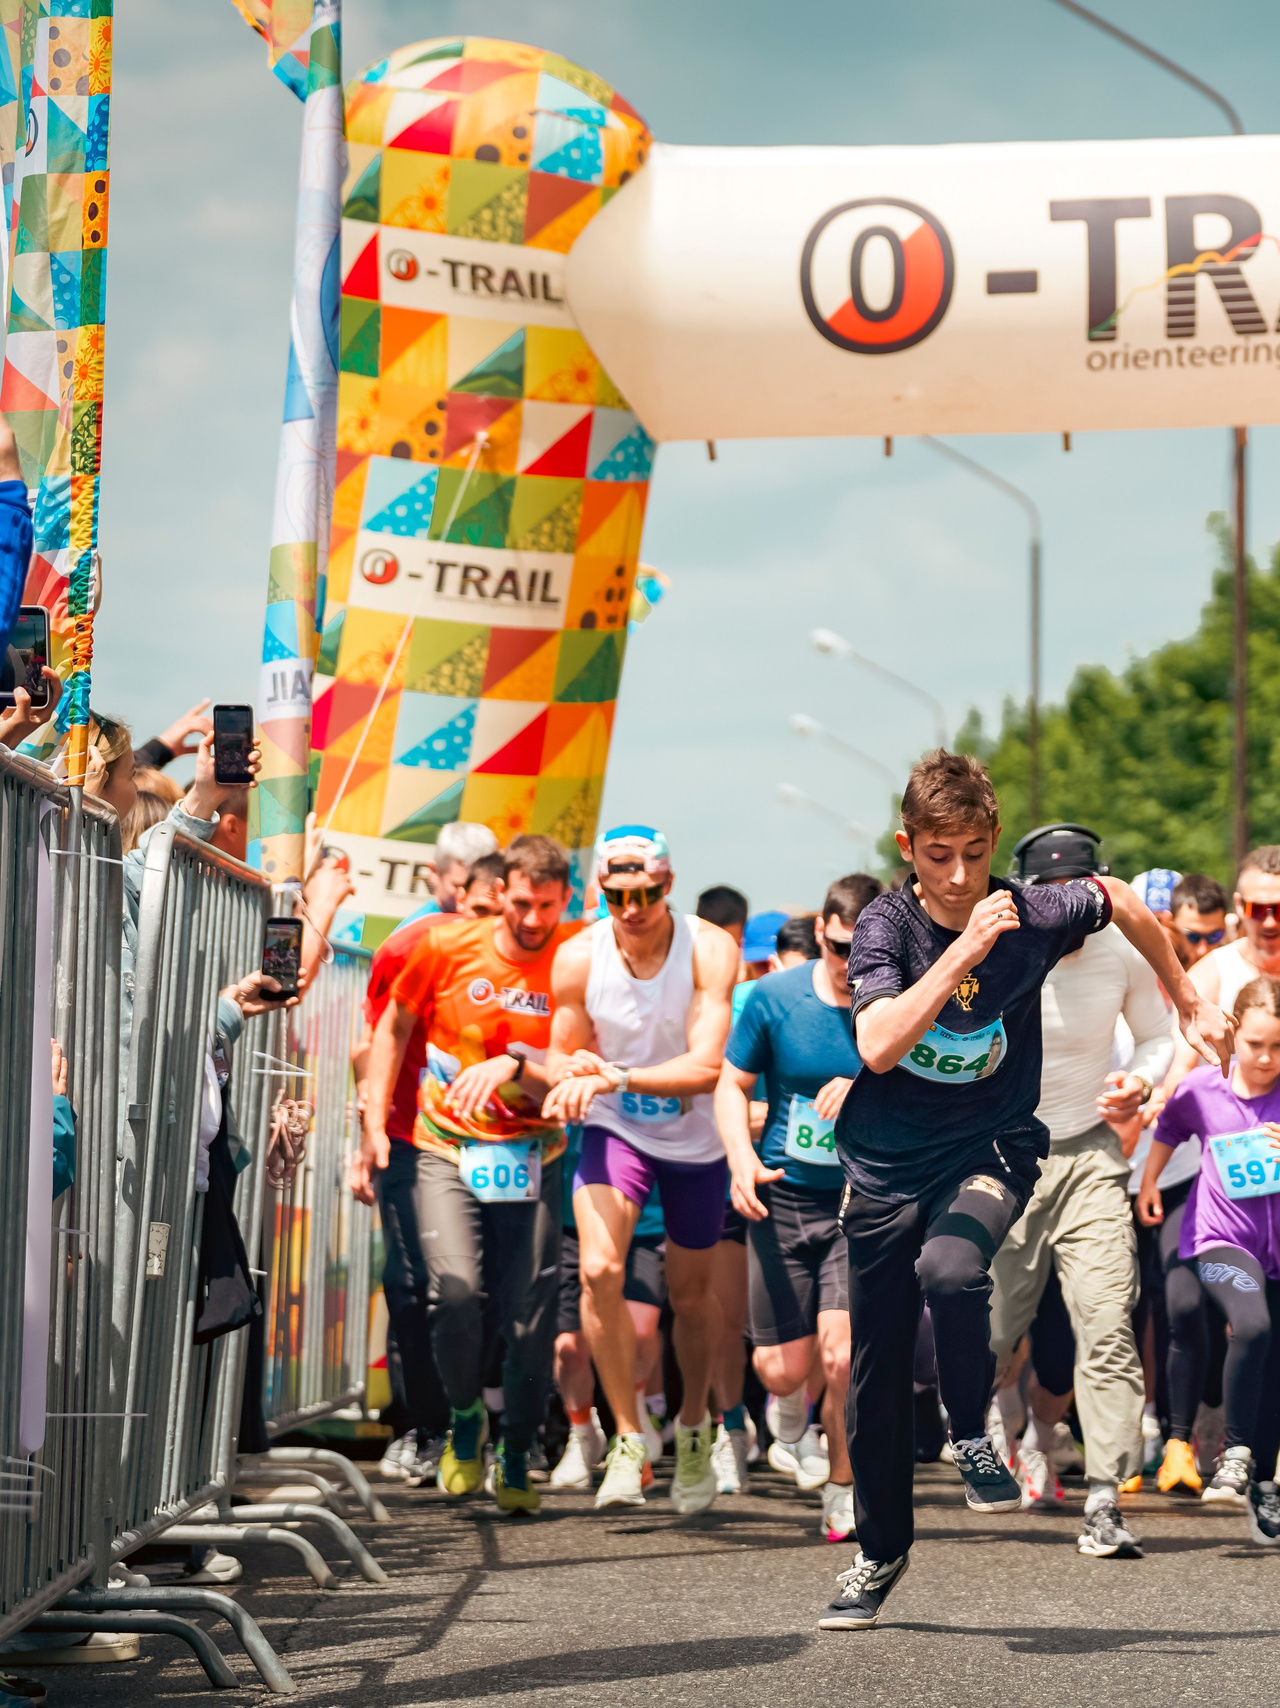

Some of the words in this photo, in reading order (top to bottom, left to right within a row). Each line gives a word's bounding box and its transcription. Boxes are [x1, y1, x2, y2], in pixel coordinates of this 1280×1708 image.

[909, 1043, 991, 1074] 864
[621, 1091, 680, 1116] 553
[471, 1164, 529, 1189] 606
